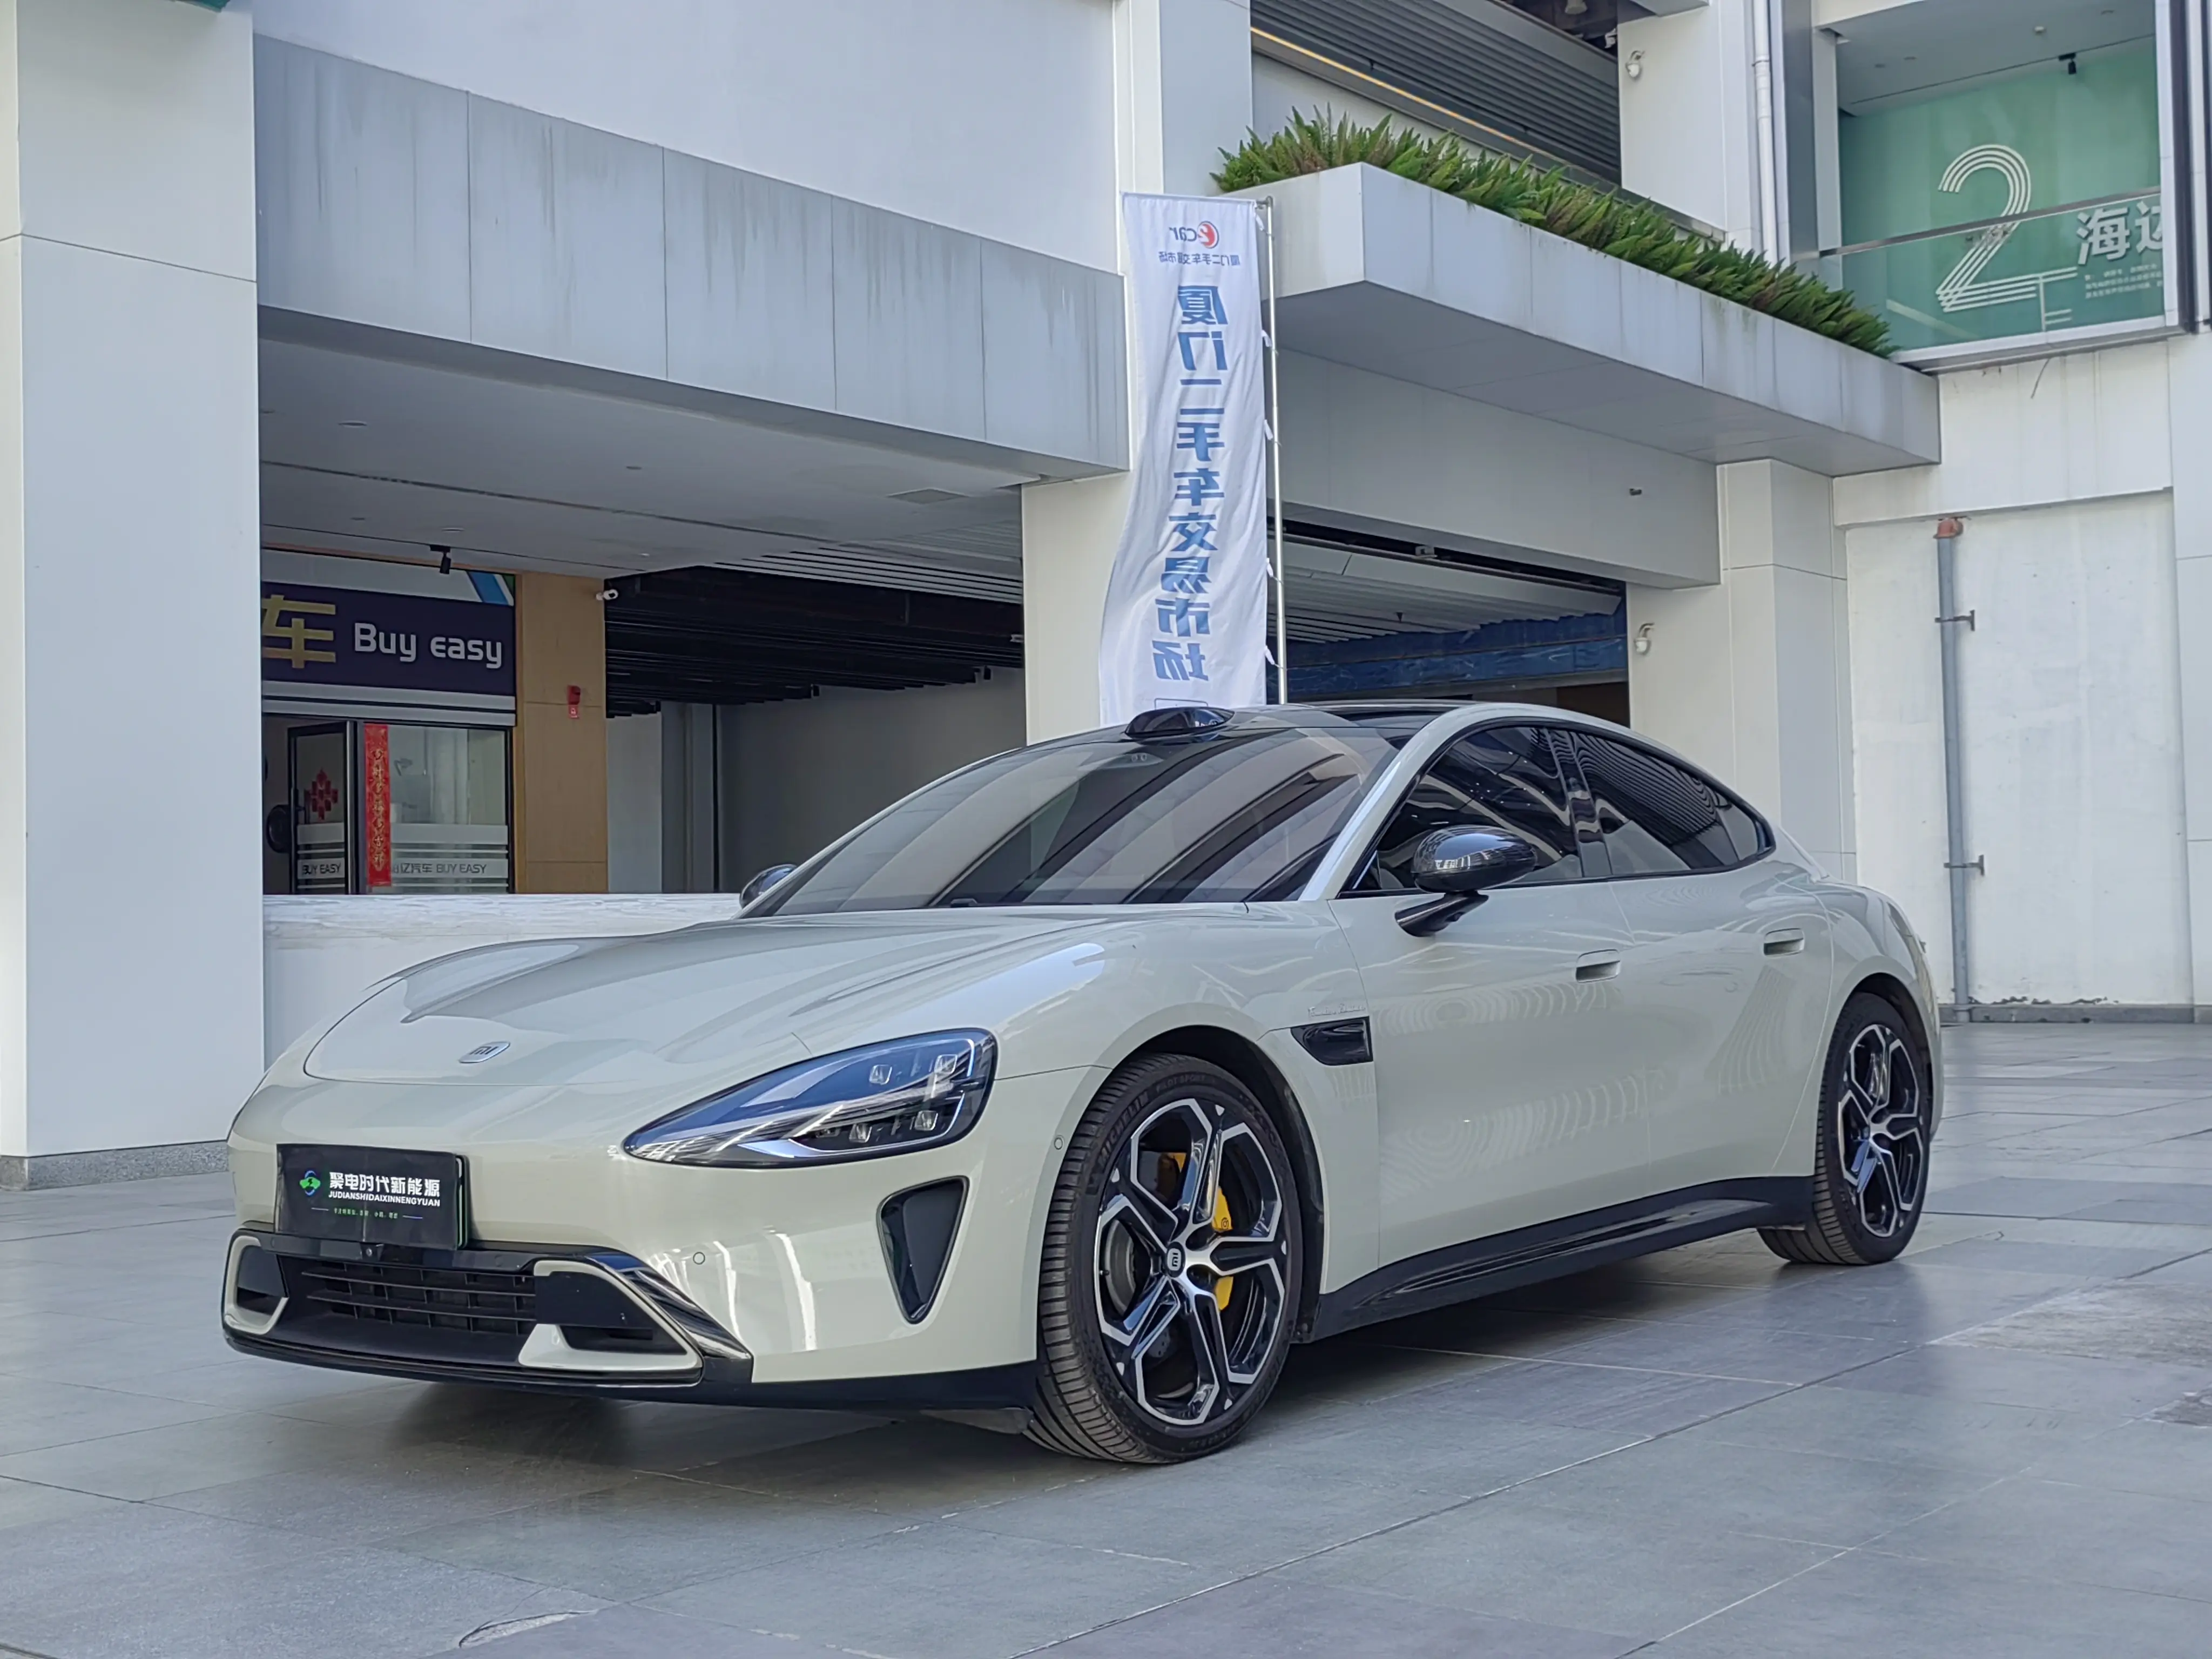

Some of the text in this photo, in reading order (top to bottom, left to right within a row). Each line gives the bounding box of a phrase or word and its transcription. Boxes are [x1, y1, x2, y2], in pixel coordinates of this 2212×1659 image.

[262, 595, 502, 669] 车 Buy easy
[319, 862, 342, 873] EASY
[436, 864, 457, 874] BUY
[458, 863, 487, 874] EASY
[329, 1171, 441, 1197] 聚电时代新能源
[328, 1190, 441, 1207] JUDIANSHIDAIXINNENGYUAN
